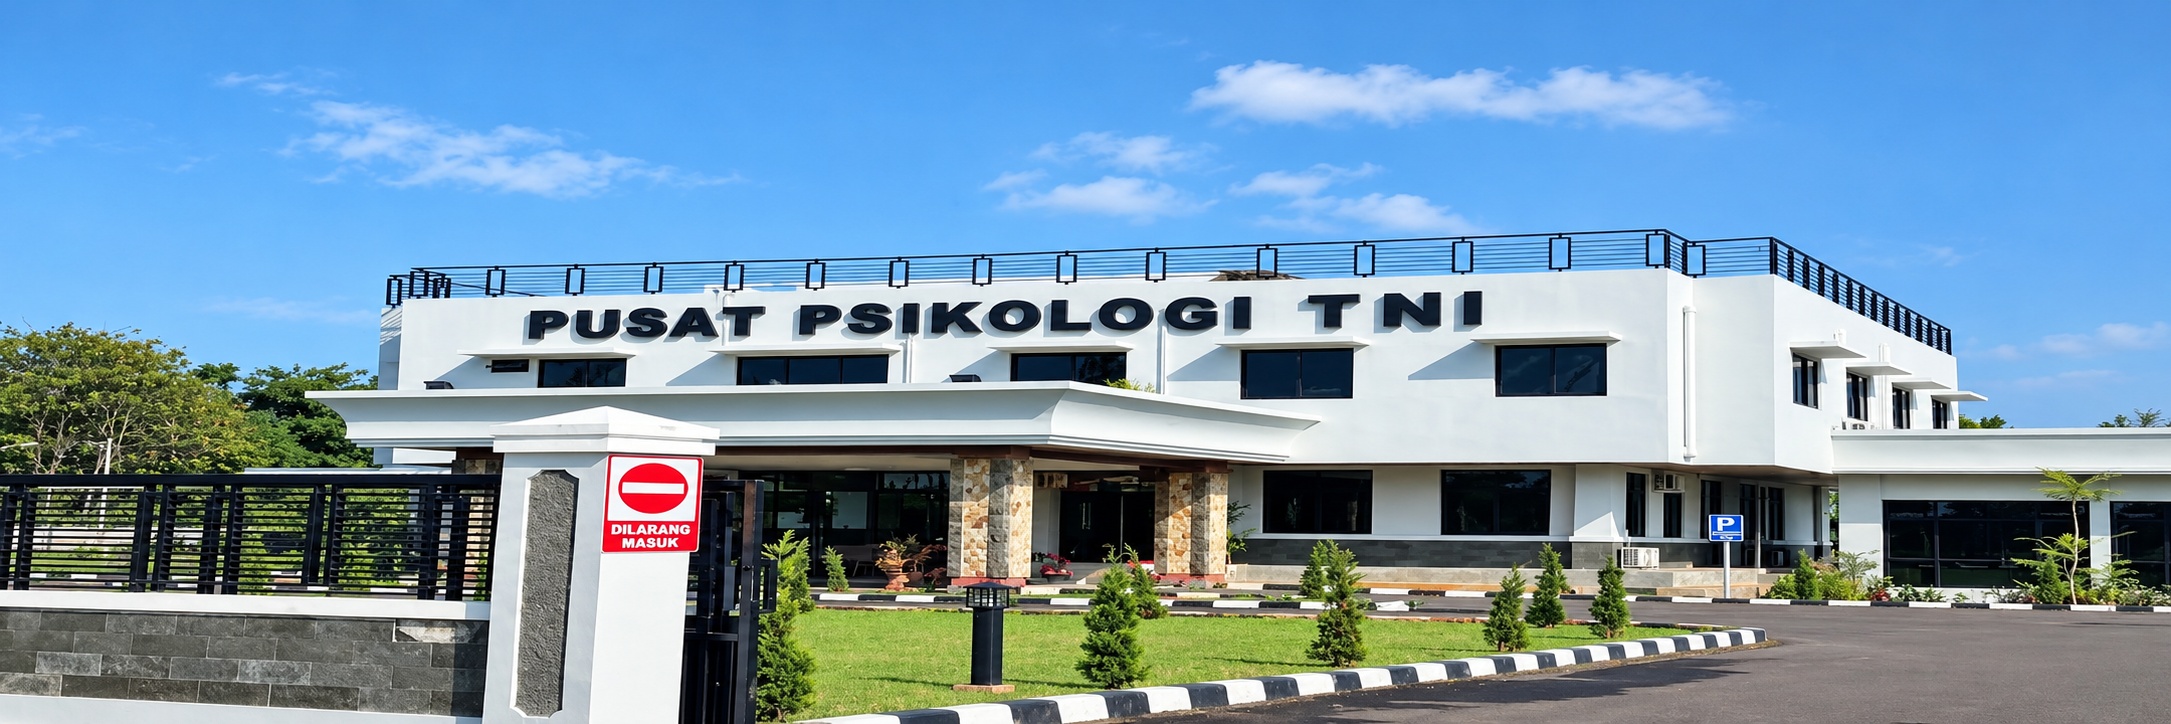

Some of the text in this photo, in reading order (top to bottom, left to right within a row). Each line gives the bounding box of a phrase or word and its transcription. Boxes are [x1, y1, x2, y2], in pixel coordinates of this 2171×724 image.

[528, 290, 1483, 340] PUSAT PSIKOLOGI TNI
[611, 524, 691, 535] DILARANG
[1717, 517, 1735, 531] P
[622, 537, 679, 549] MASUK
